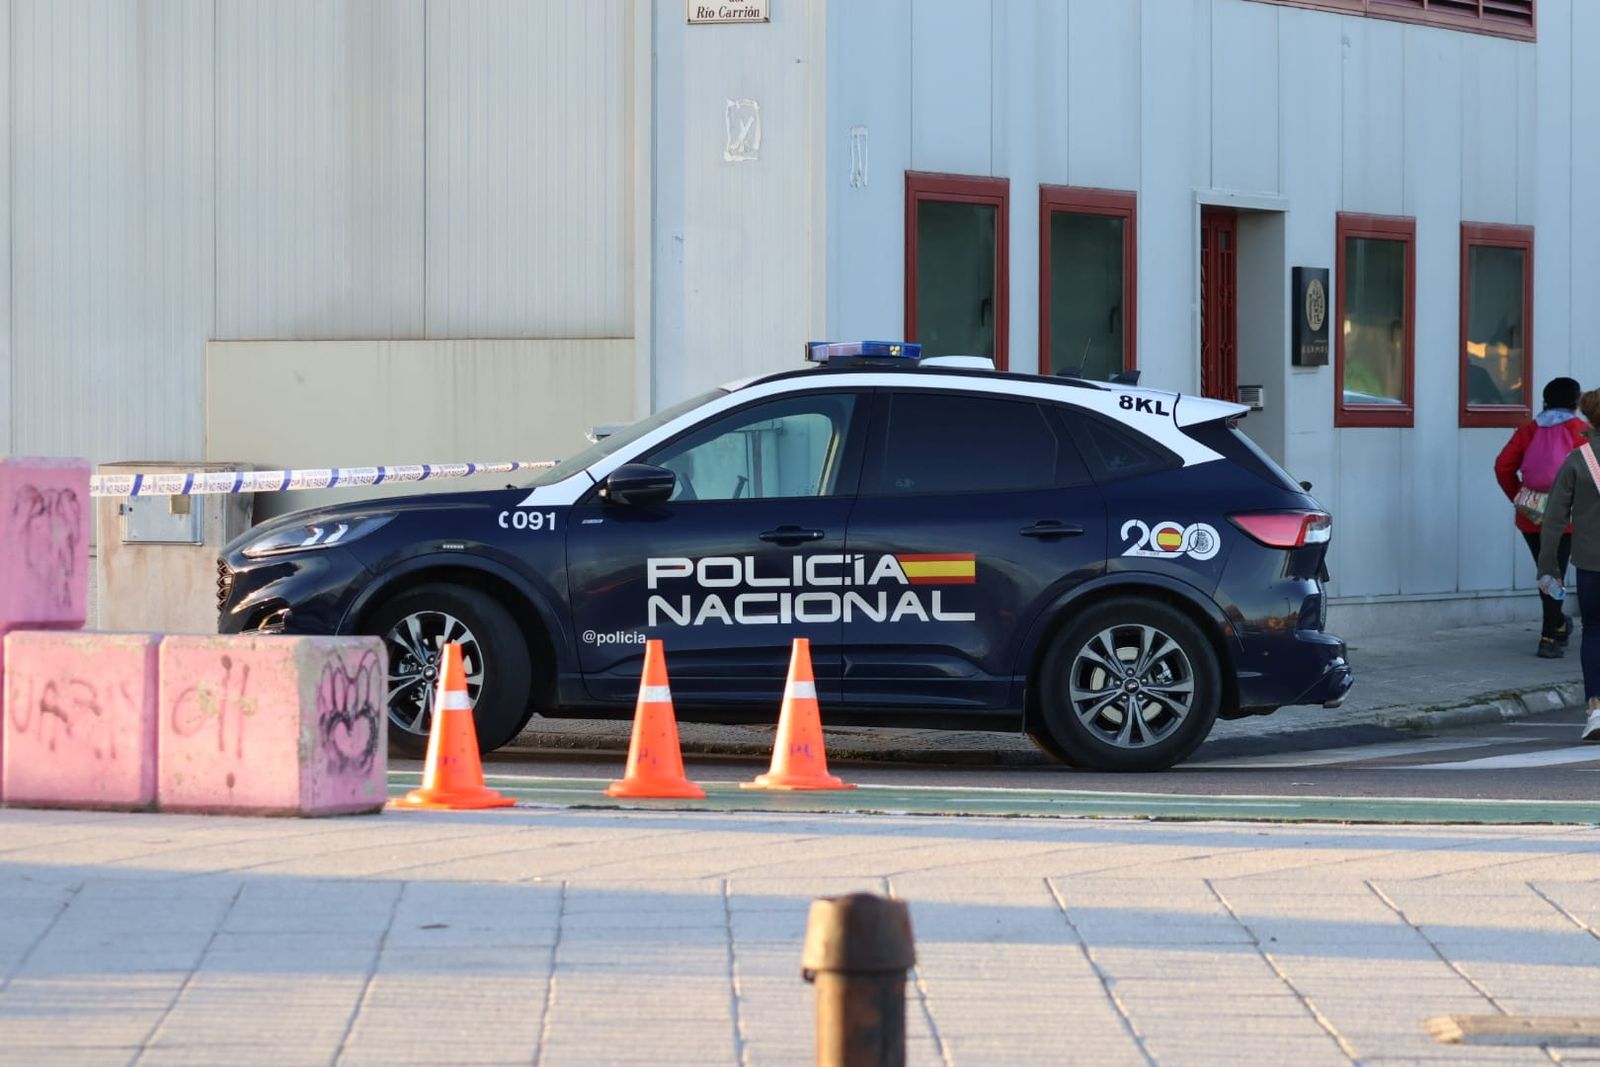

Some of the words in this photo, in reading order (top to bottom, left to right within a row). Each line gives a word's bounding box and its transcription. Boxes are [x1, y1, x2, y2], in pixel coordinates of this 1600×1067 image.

[697, 7, 715, 18] Río
[719, 6, 760, 18] Carrión
[1119, 395, 1170, 417] 8KL
[647, 590, 976, 627] NACIONAL
[582, 629, 647, 647] @policia
